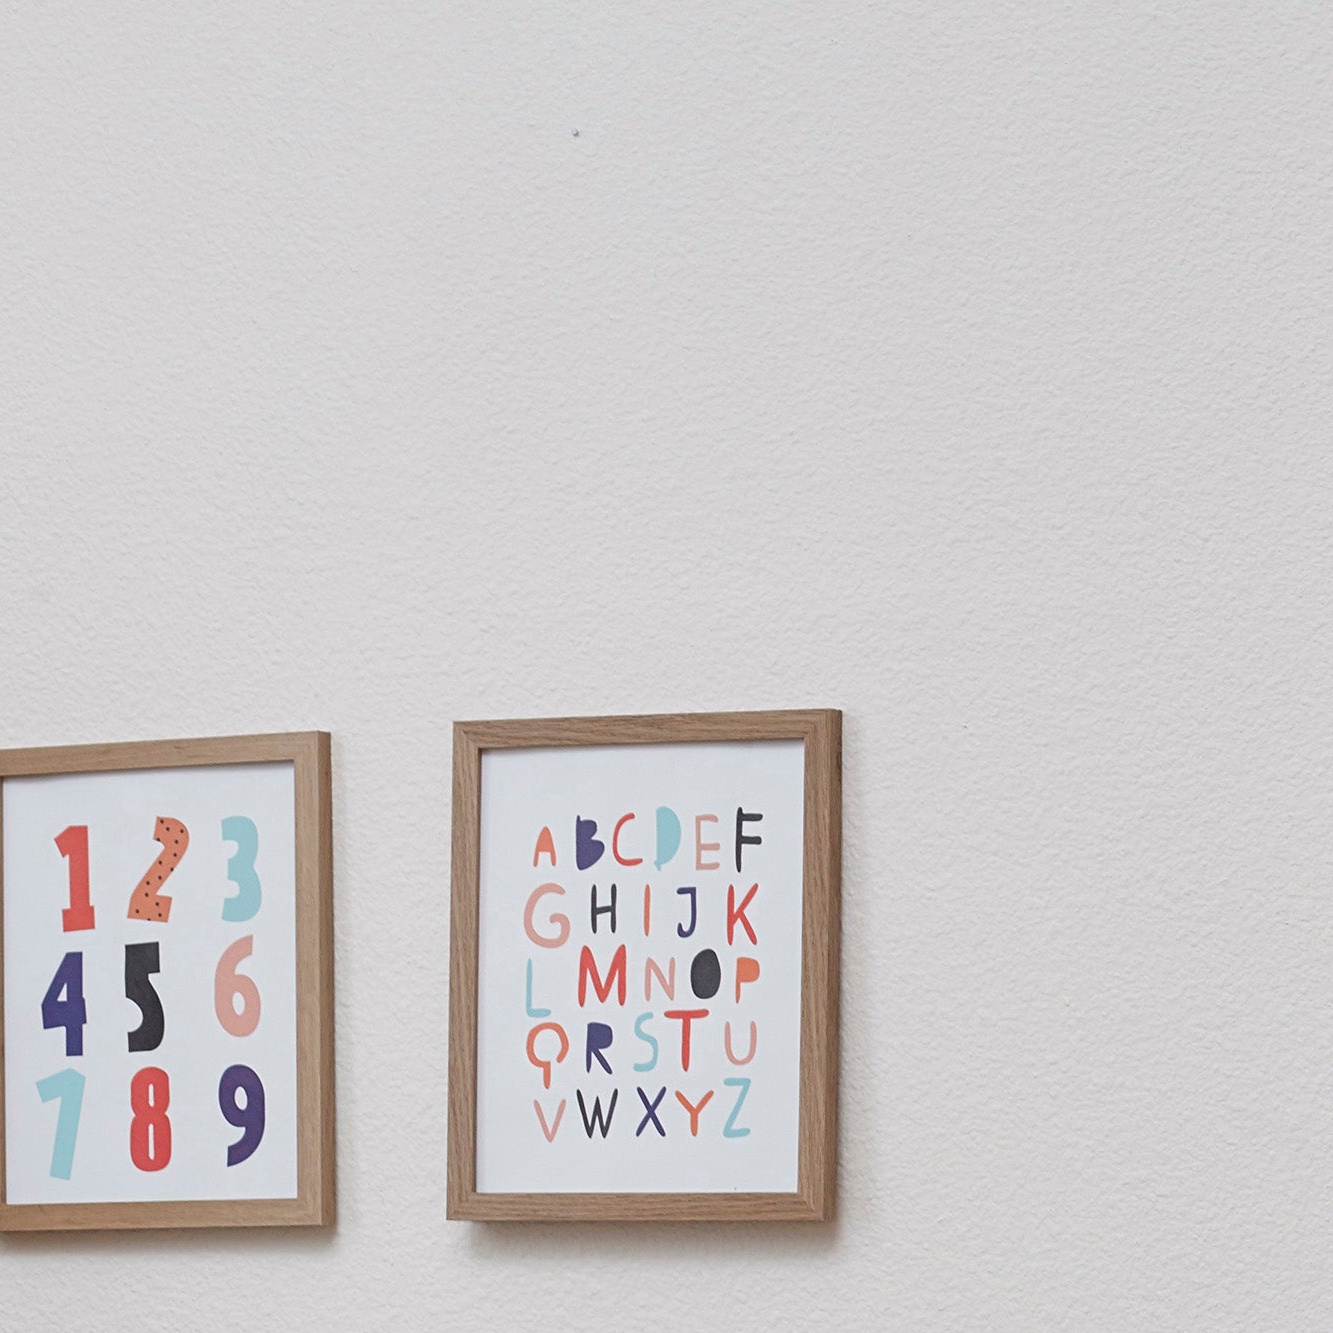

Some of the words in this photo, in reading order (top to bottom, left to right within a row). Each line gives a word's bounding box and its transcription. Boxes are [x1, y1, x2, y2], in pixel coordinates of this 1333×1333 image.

[53, 824, 96, 933] 1
[126, 815, 190, 924] 2
[220, 815, 263, 924] 3
[40, 950, 88, 1057] 4
[124, 941, 165, 1053] 5
[213, 934, 262, 1038] 6
[34, 1067, 87, 1182] 7
[129, 1066, 172, 1173] 8
[218, 1063, 266, 1168] 9
